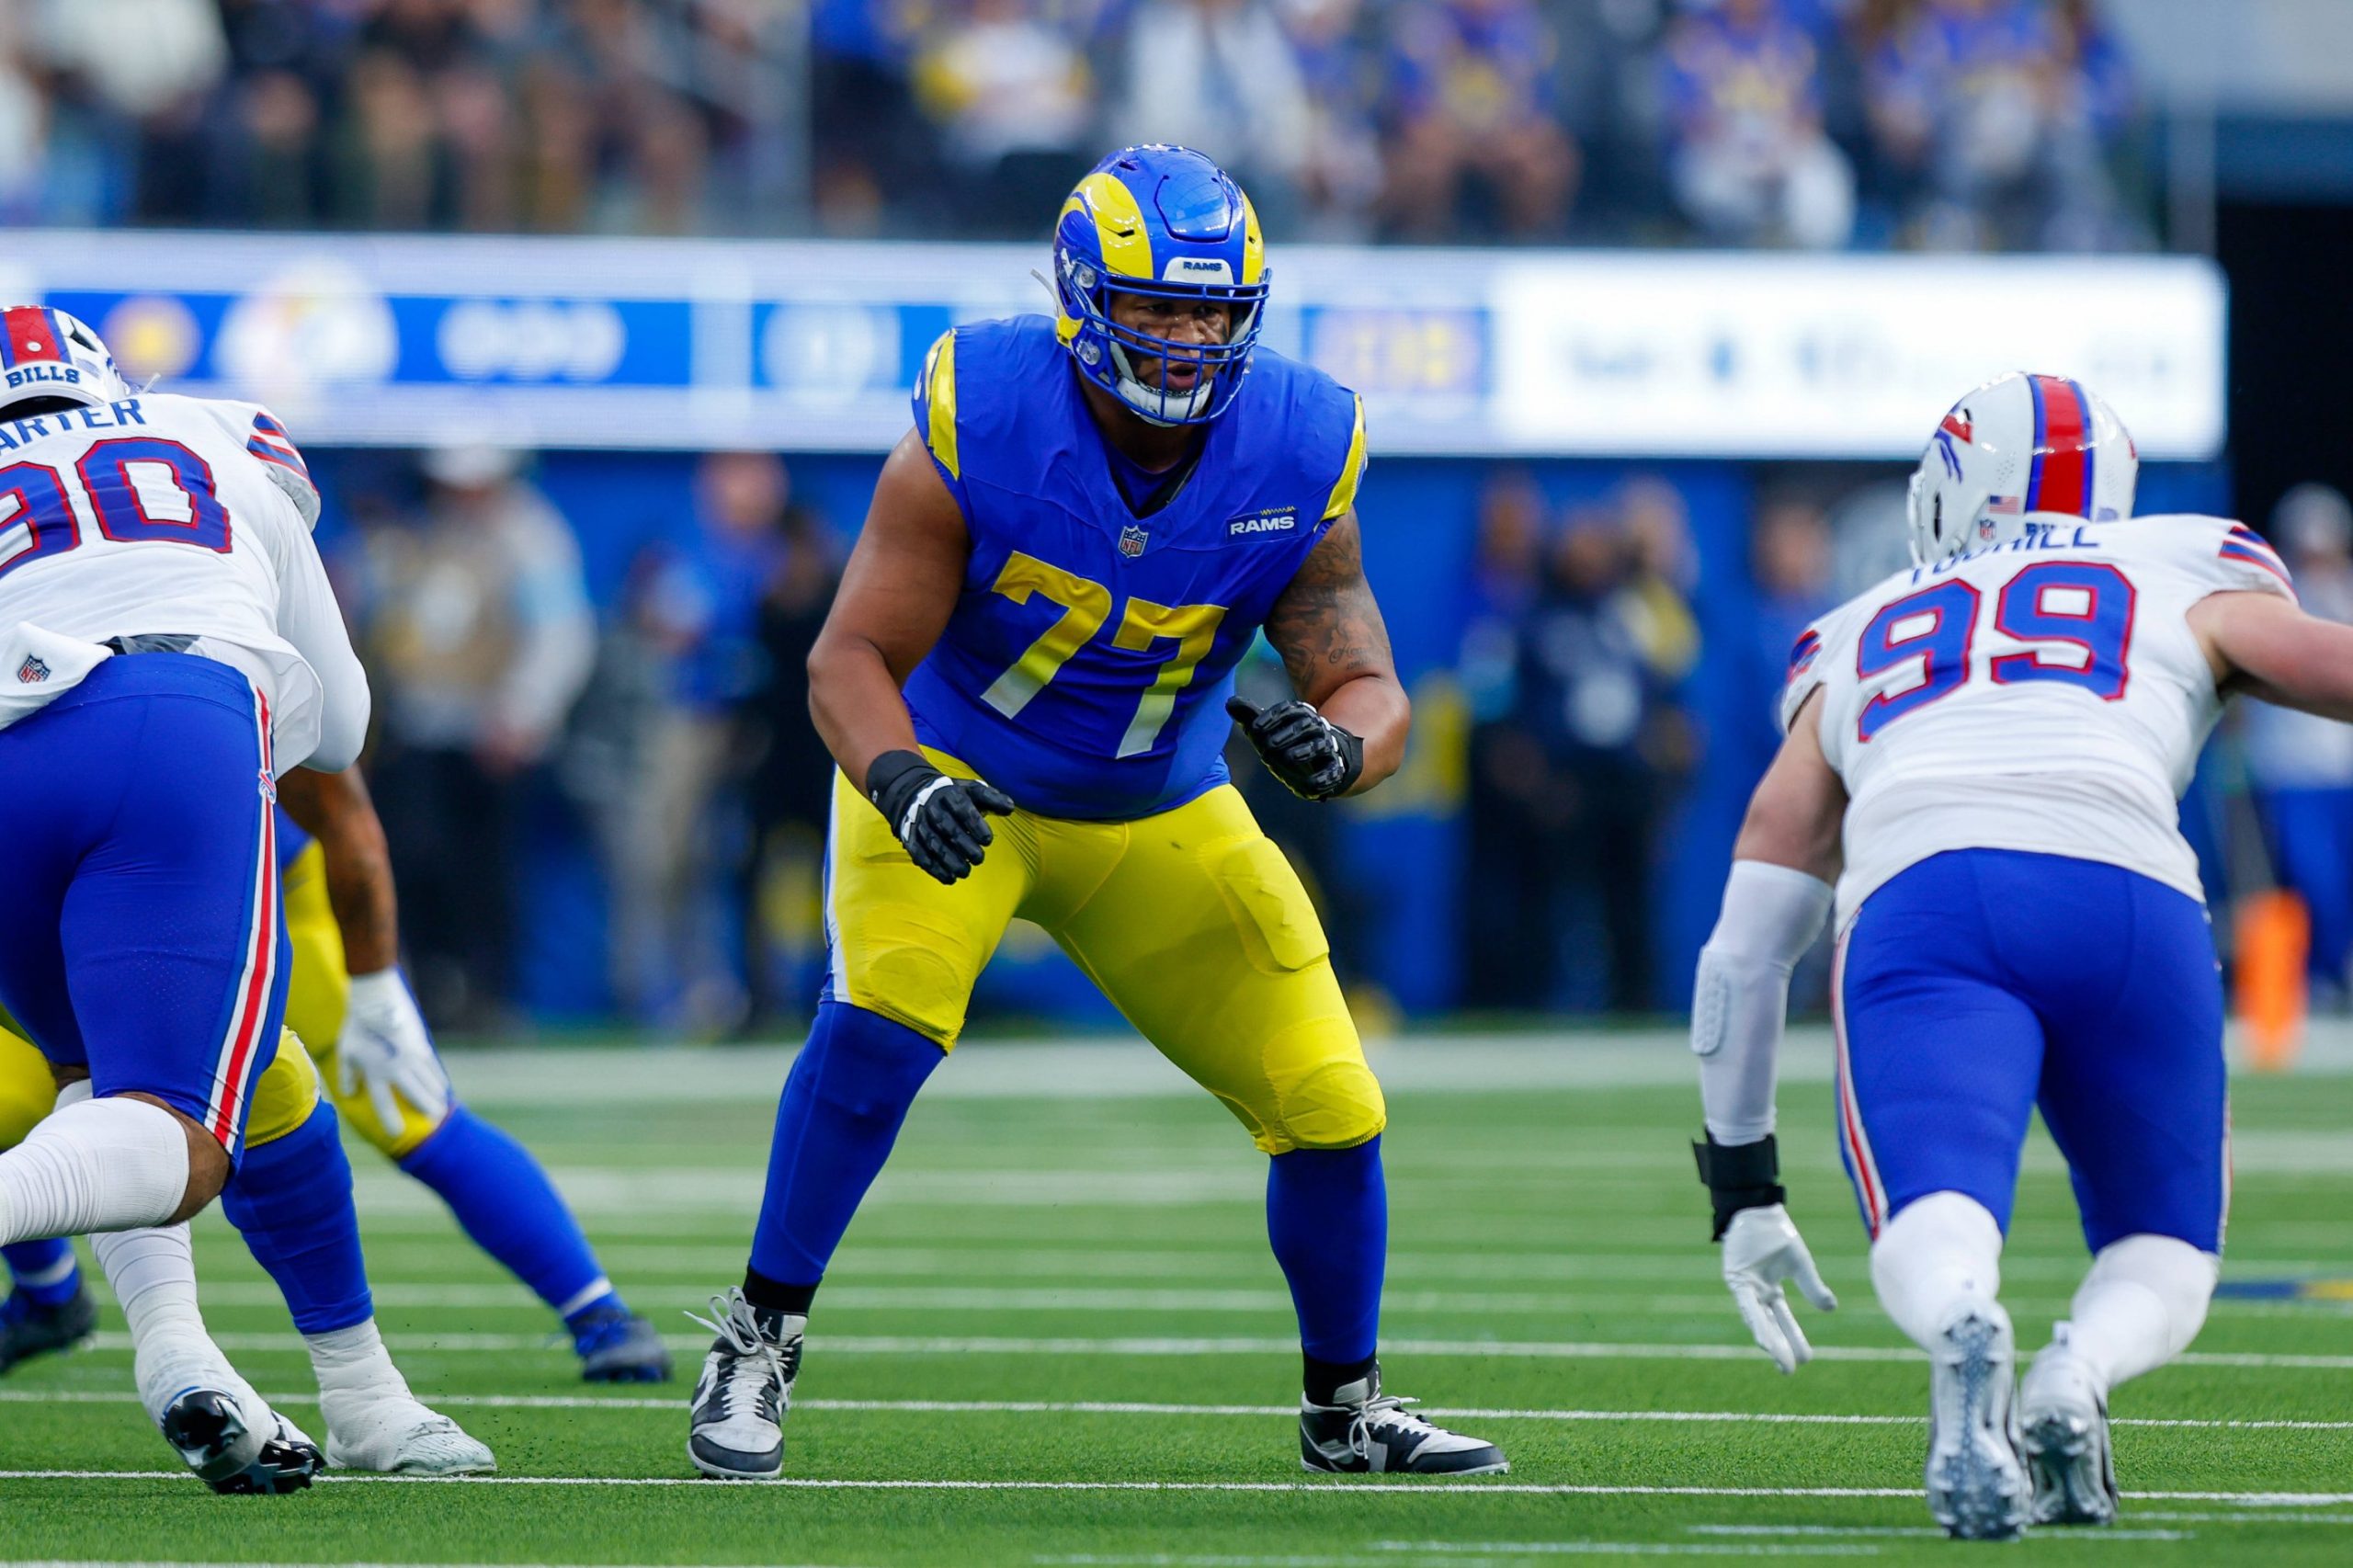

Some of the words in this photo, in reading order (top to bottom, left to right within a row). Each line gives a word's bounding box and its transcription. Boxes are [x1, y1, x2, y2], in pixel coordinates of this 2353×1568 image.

[1183, 261, 1223, 272] RAMS
[6, 366, 81, 389] BILLS
[1230, 516, 1295, 536] RAMS
[979, 550, 1230, 760] 77
[1856, 561, 2138, 744] 99
